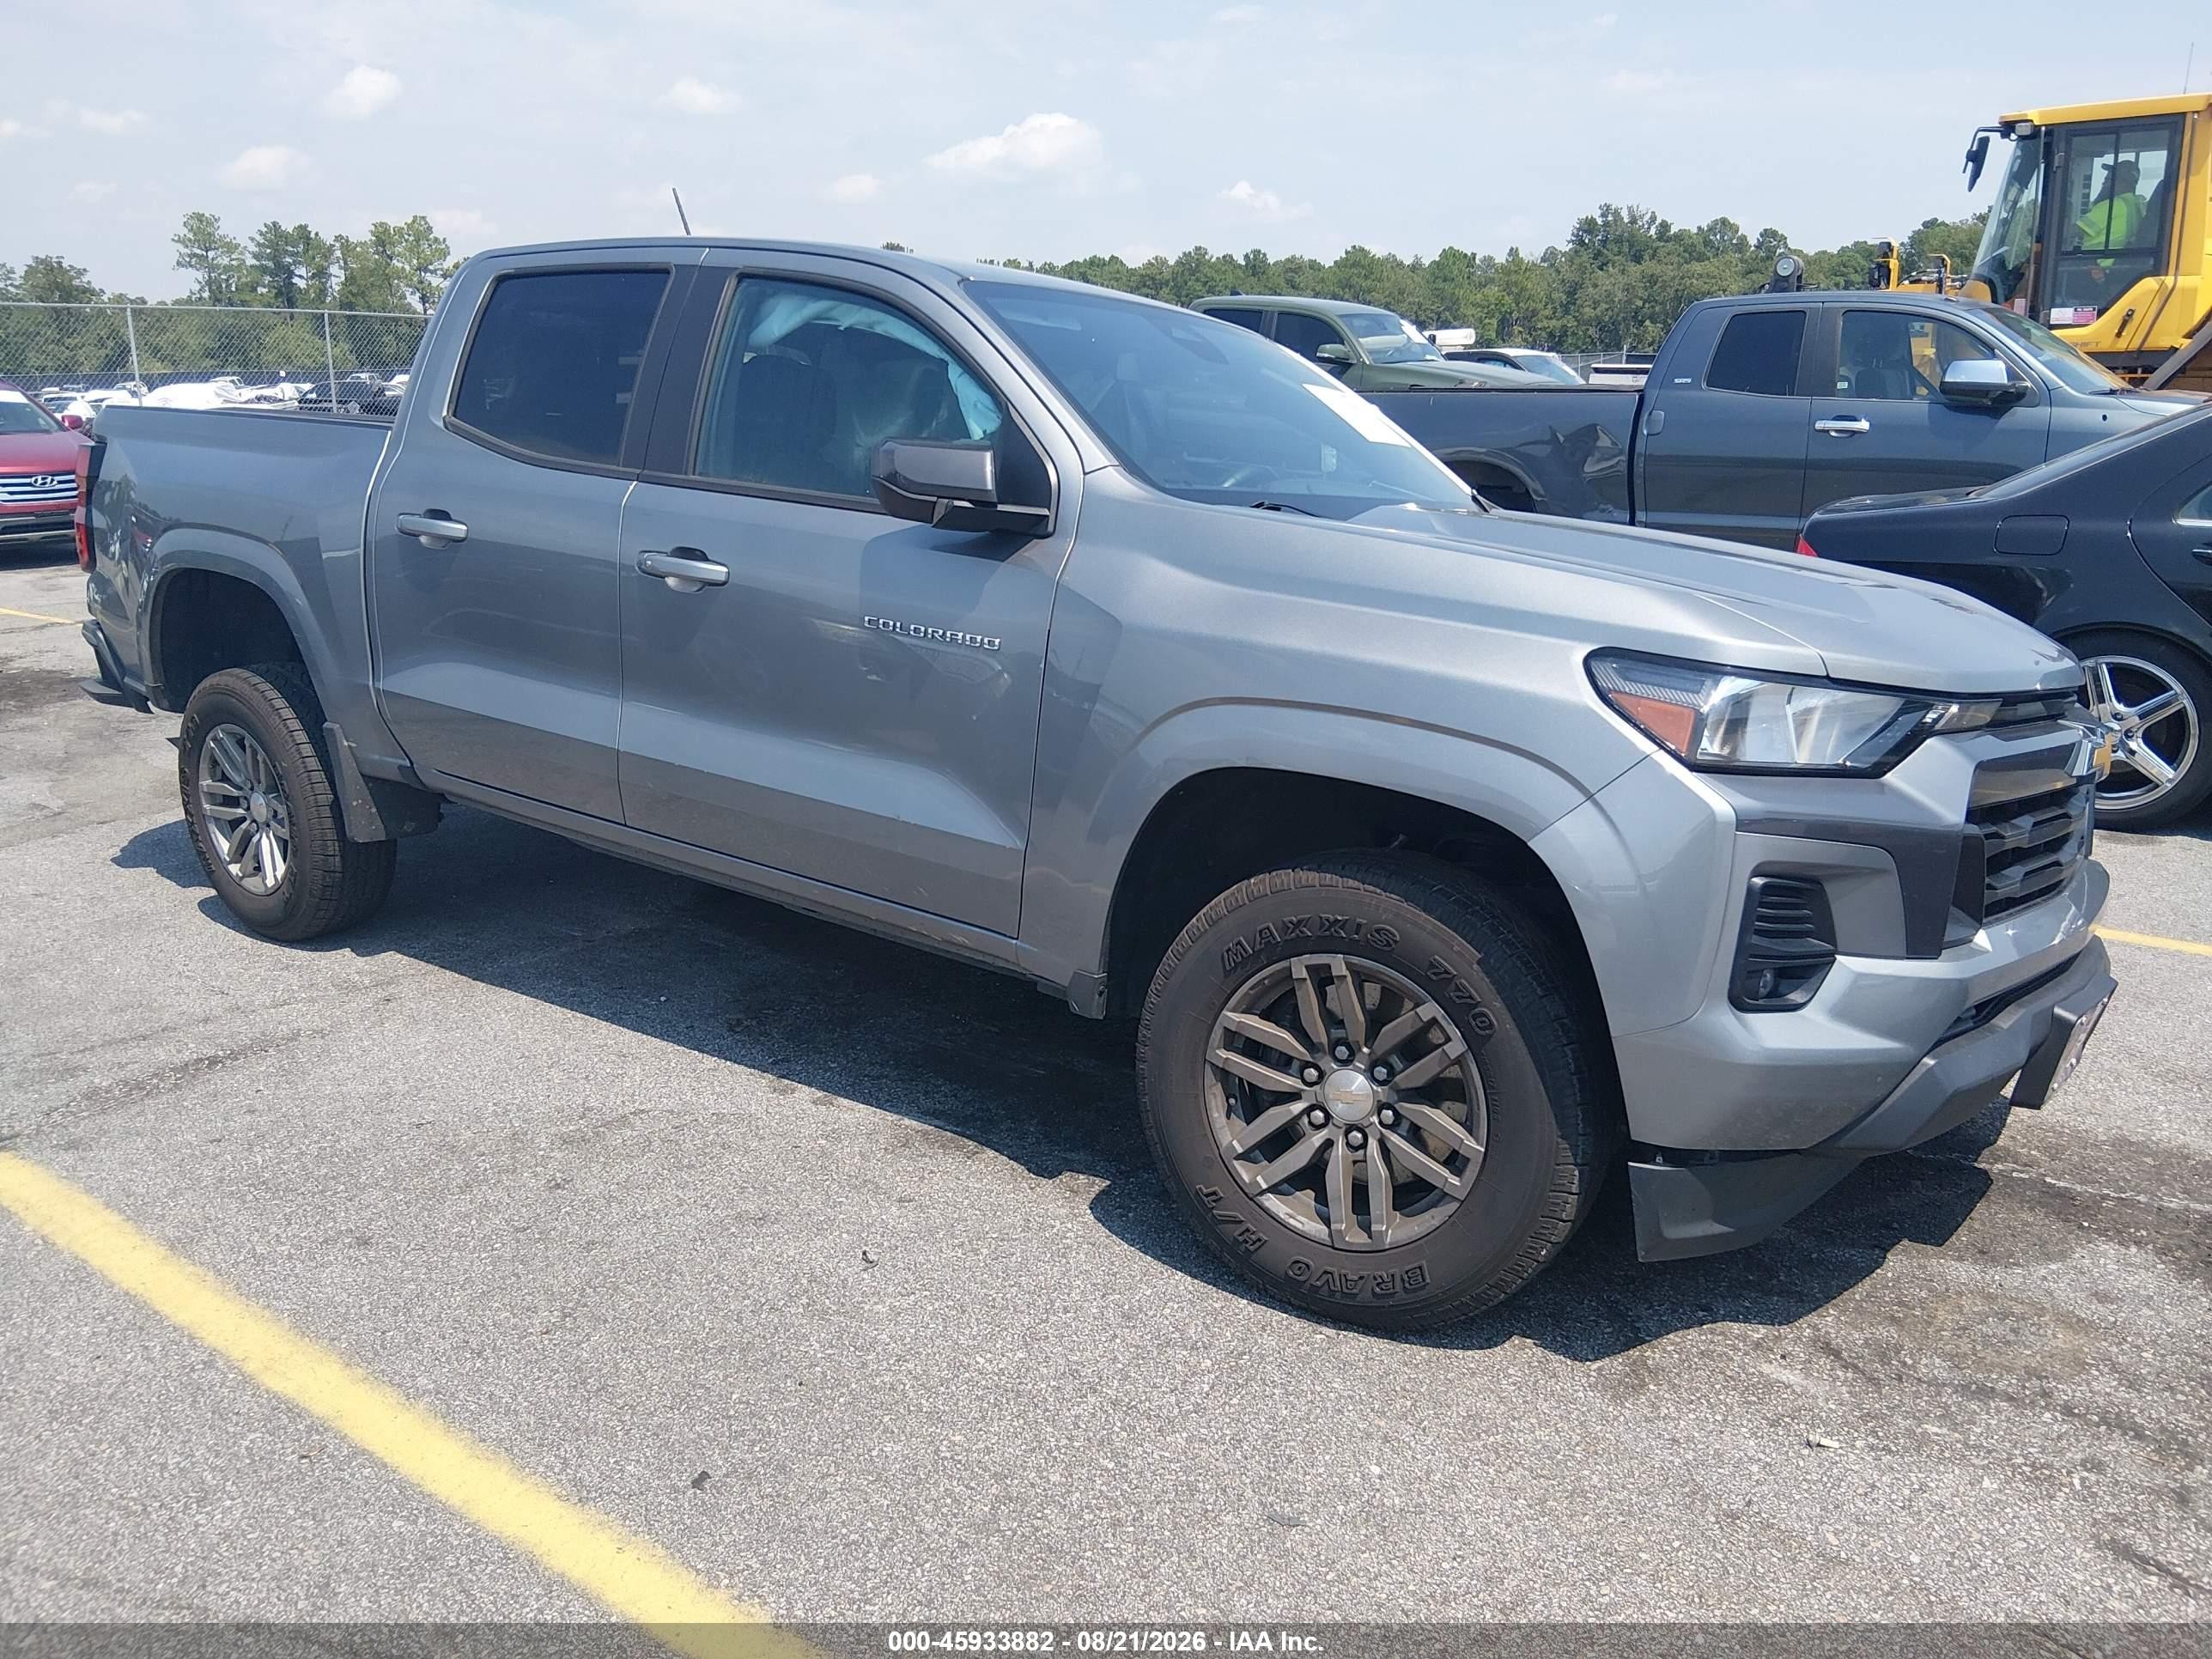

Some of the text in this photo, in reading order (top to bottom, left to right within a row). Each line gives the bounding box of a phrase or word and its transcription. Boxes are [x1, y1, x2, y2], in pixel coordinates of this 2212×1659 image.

[864, 616, 1001, 650] COLORADO
[1221, 913, 1498, 1036] MAXXIS 770
[1195, 1184, 1431, 1295] BRAVO H/T
